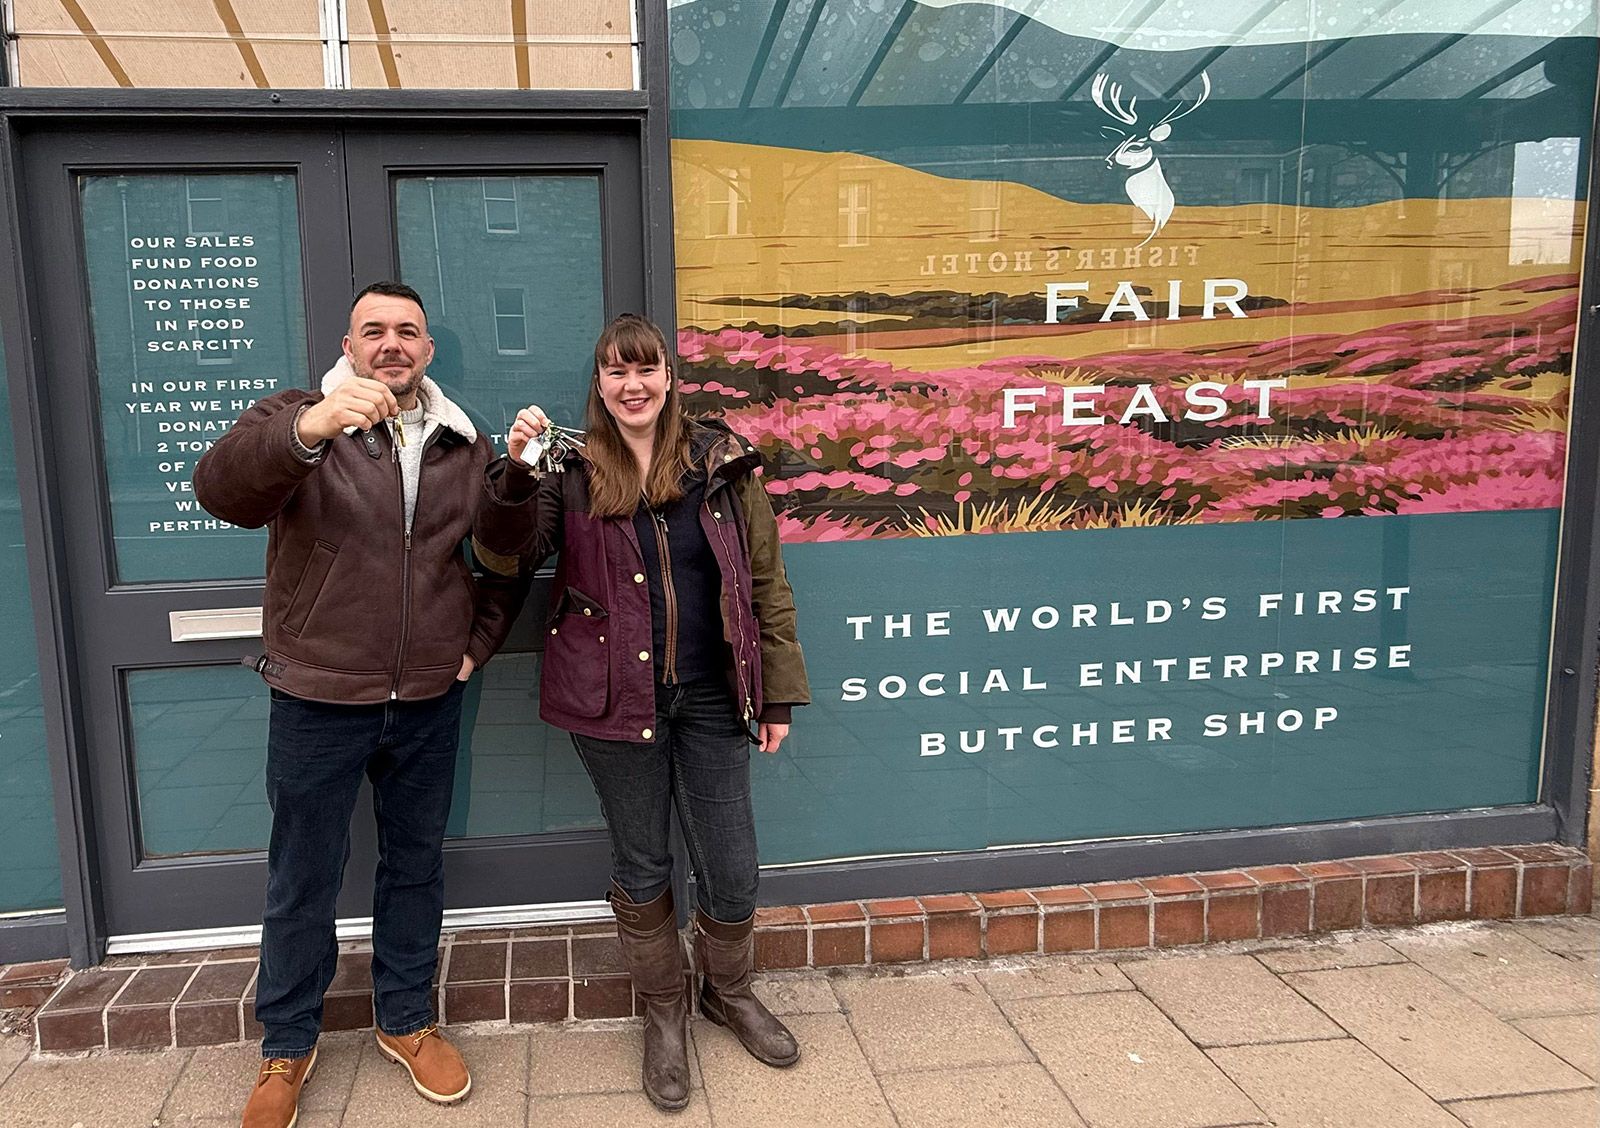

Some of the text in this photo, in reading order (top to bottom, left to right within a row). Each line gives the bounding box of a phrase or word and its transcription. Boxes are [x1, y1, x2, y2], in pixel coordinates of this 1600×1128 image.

[130, 235, 255, 249] OUR SALES
[131, 256, 258, 270] FUND FOOD
[133, 277, 260, 291] DONATIONS
[144, 297, 251, 311] TO THOSE
[1044, 278, 1249, 324] FAIR
[155, 318, 245, 331] IN FOOD
[147, 338, 254, 352] SCARCITY
[131, 378, 278, 393] IN OUR FIRST
[125, 399, 256, 414] YEAR WE HA
[1001, 377, 1287, 429] FEAST
[158, 419, 238, 433] DONAT
[157, 440, 216, 453] 2 TON
[158, 461, 185, 473] OF
[165, 481, 192, 492] VE
[175, 500, 201, 512] WI
[149, 519, 240, 533] PERTHS
[846, 587, 1411, 640] THE WORLD’S FIRST
[841, 644, 1412, 701] SOCIAL ENTERPRISE
[920, 707, 1338, 757] BUTCHER SHOP
